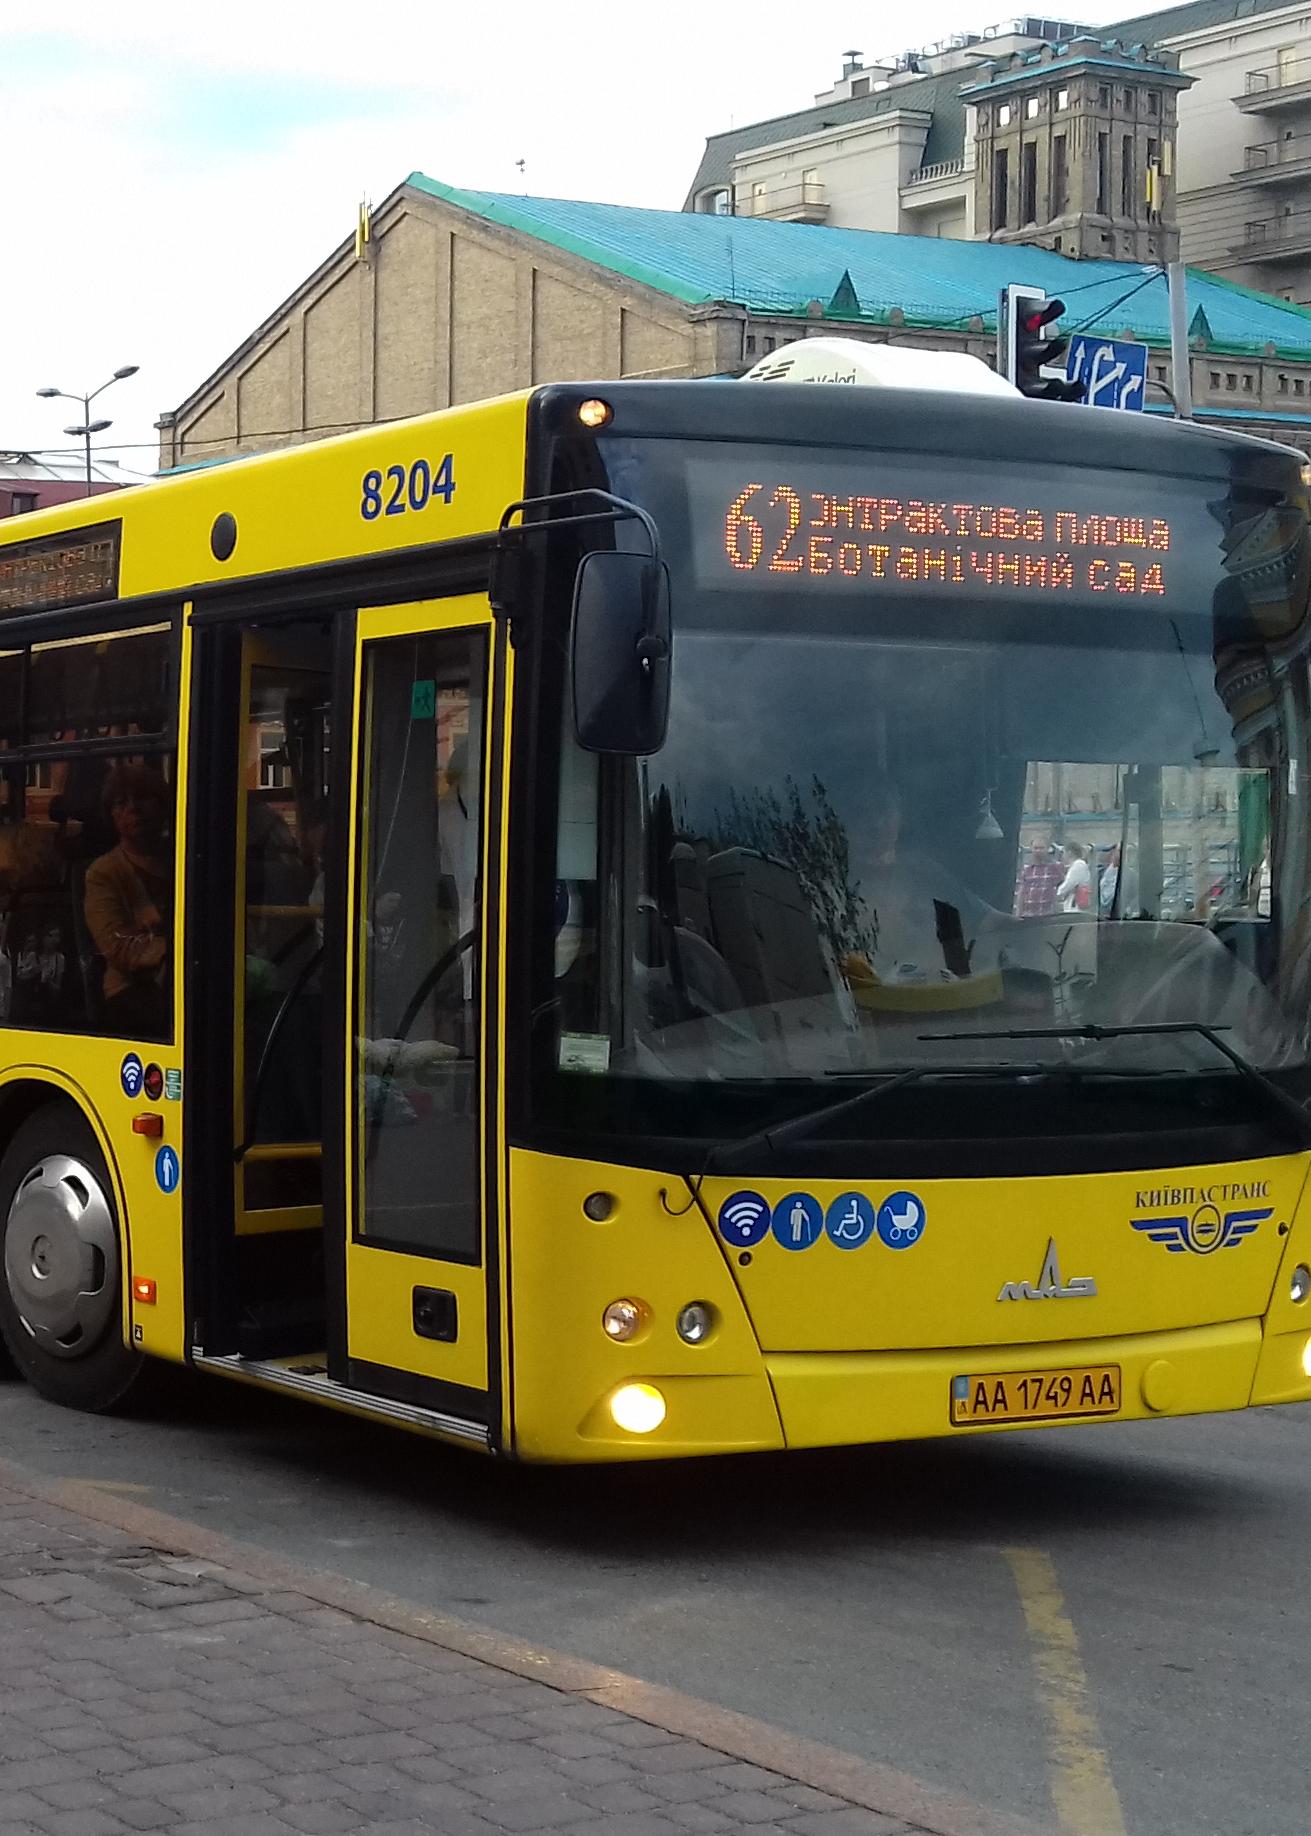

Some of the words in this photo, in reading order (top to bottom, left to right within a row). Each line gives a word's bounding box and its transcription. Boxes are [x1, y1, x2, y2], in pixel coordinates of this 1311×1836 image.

[360, 453, 457, 521] 8204
[724, 482, 805, 572] 62
[809, 535, 1074, 590] Ботанічний
[1088, 559, 1166, 596] сад
[1135, 1179, 1273, 1209] КИЇВПАСТРАНС
[972, 1381, 1009, 1415] AA
[1016, 1375, 1073, 1411] 1749
[1079, 1373, 1116, 1407] AA
